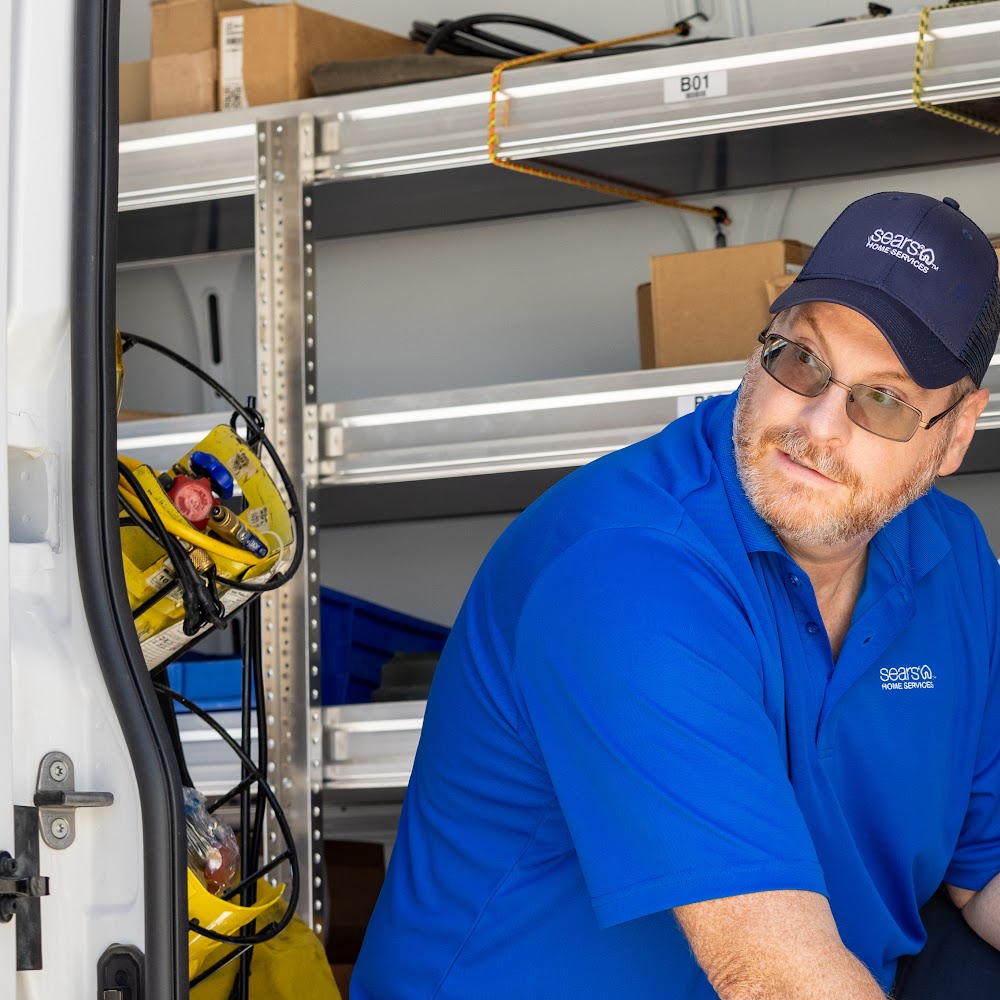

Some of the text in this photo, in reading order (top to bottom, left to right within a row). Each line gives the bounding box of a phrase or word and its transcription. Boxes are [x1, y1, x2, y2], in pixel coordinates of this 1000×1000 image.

[681, 75, 709, 91] B01
[865, 241, 930, 274] HOME SERVICES
[881, 681, 935, 690] HOME SERVICES
